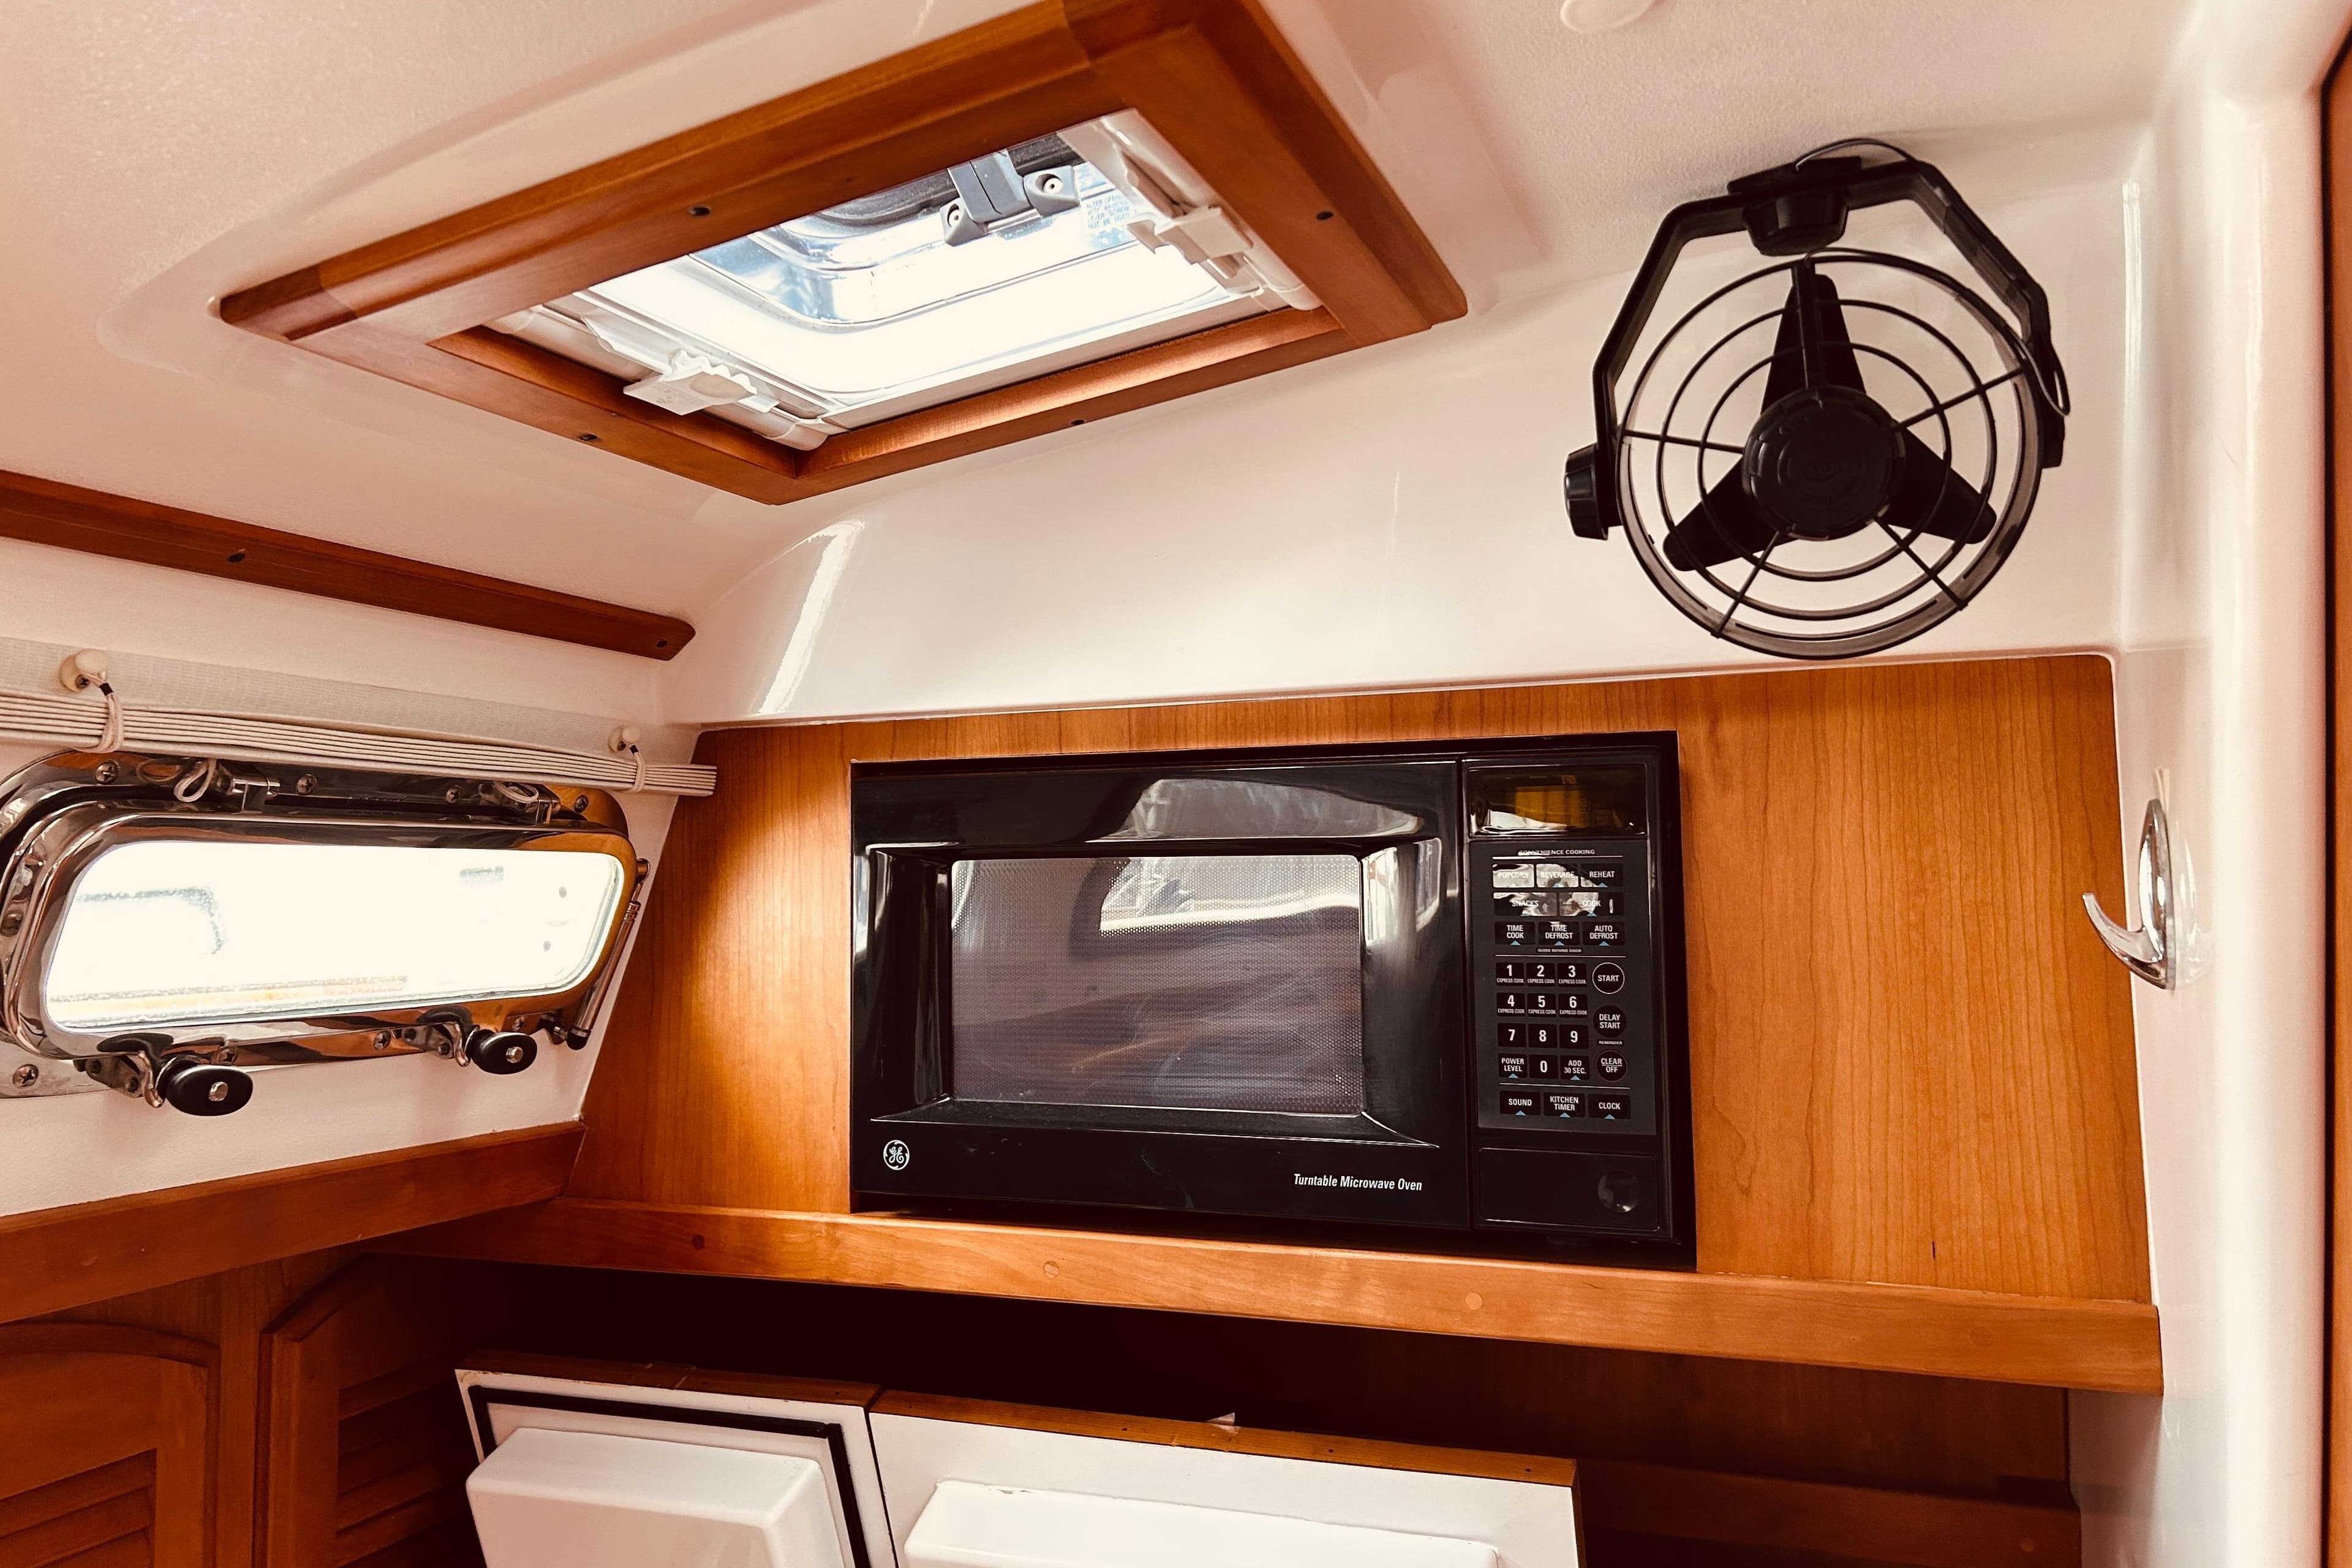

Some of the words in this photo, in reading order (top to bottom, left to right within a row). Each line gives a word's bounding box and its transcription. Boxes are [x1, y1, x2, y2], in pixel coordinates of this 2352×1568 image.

[1506, 964, 1513, 976] 1
[1536, 965, 1545, 977] 2
[1568, 965, 1576, 978] 3
[1507, 995, 1515, 1007] 4
[1537, 995, 1546, 1008] 5
[1569, 996, 1577, 1008] 6
[1508, 1029, 1515, 1041] 7
[1539, 1030, 1547, 1042] 8
[1570, 1030, 1578, 1043] 9
[1540, 1060, 1548, 1073] 0
[1294, 1173, 1338, 1187] Turntable
[1340, 1175, 1395, 1189] Microwave
[1397, 1178, 1422, 1191] Oven
